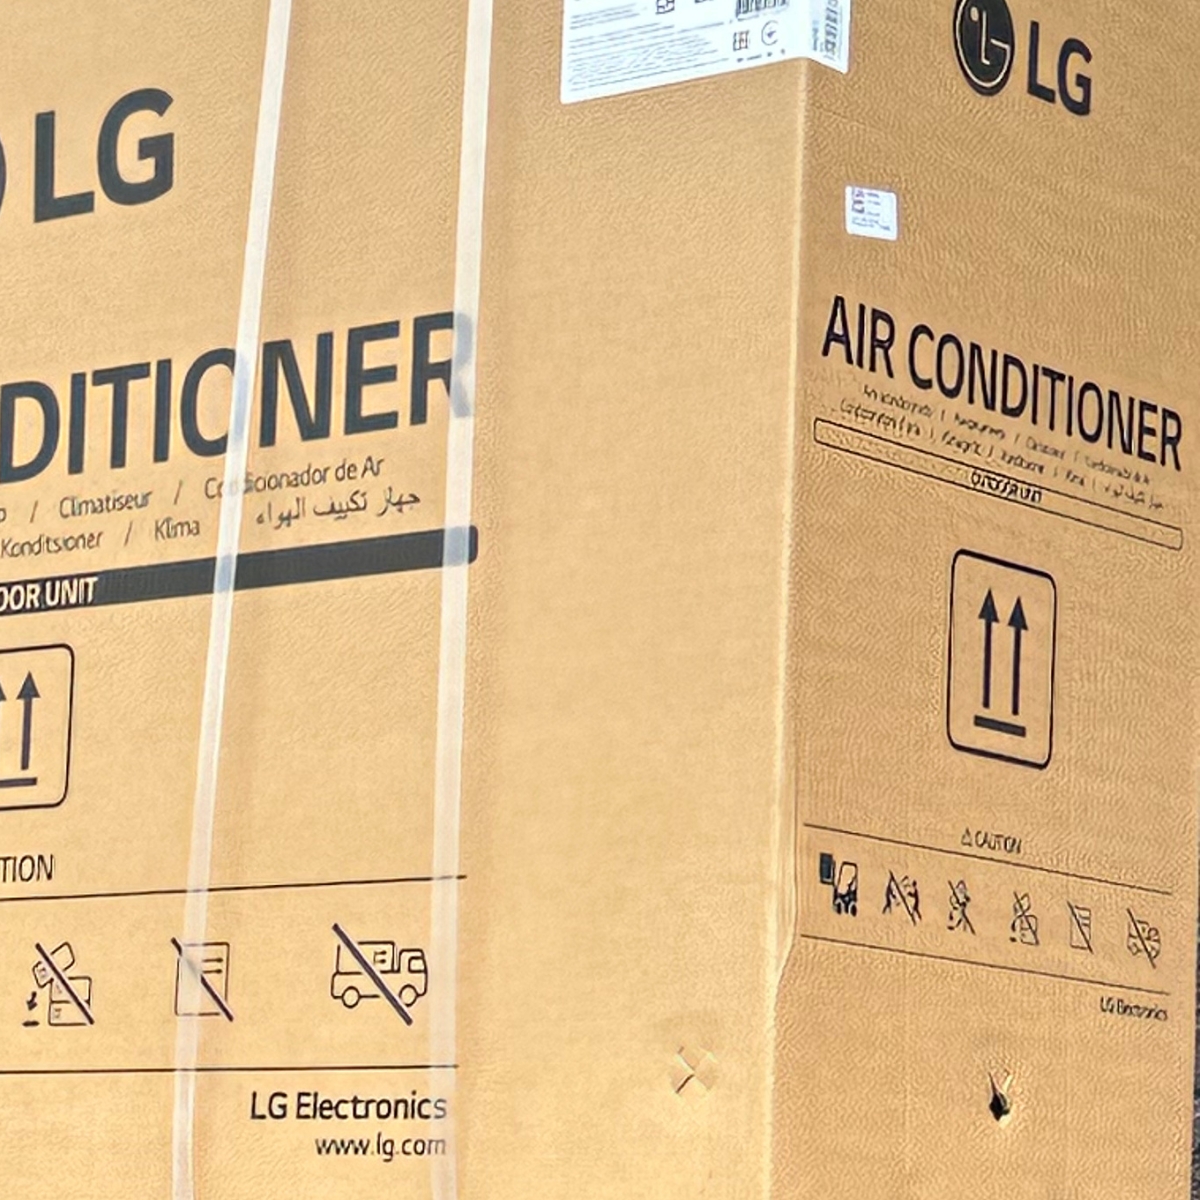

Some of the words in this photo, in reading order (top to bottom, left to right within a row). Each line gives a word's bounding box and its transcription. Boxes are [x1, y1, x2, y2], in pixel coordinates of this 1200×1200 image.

[1027, 20, 1093, 117] LG
[34, 87, 175, 223] LG
[822, 295, 896, 379] AIR
[907, 324, 1182, 471] CONDITIONER
[59, 490, 153, 519] Climatiseur
[335, 458, 357, 480] de
[361, 455, 384, 478] Ar
[154, 516, 201, 541] Klima
[45, 576, 99, 606] UNIT
[251, 1091, 288, 1120] LG
[296, 1090, 447, 1120] Electronics
[315, 1131, 446, 1163] www.lg.com
